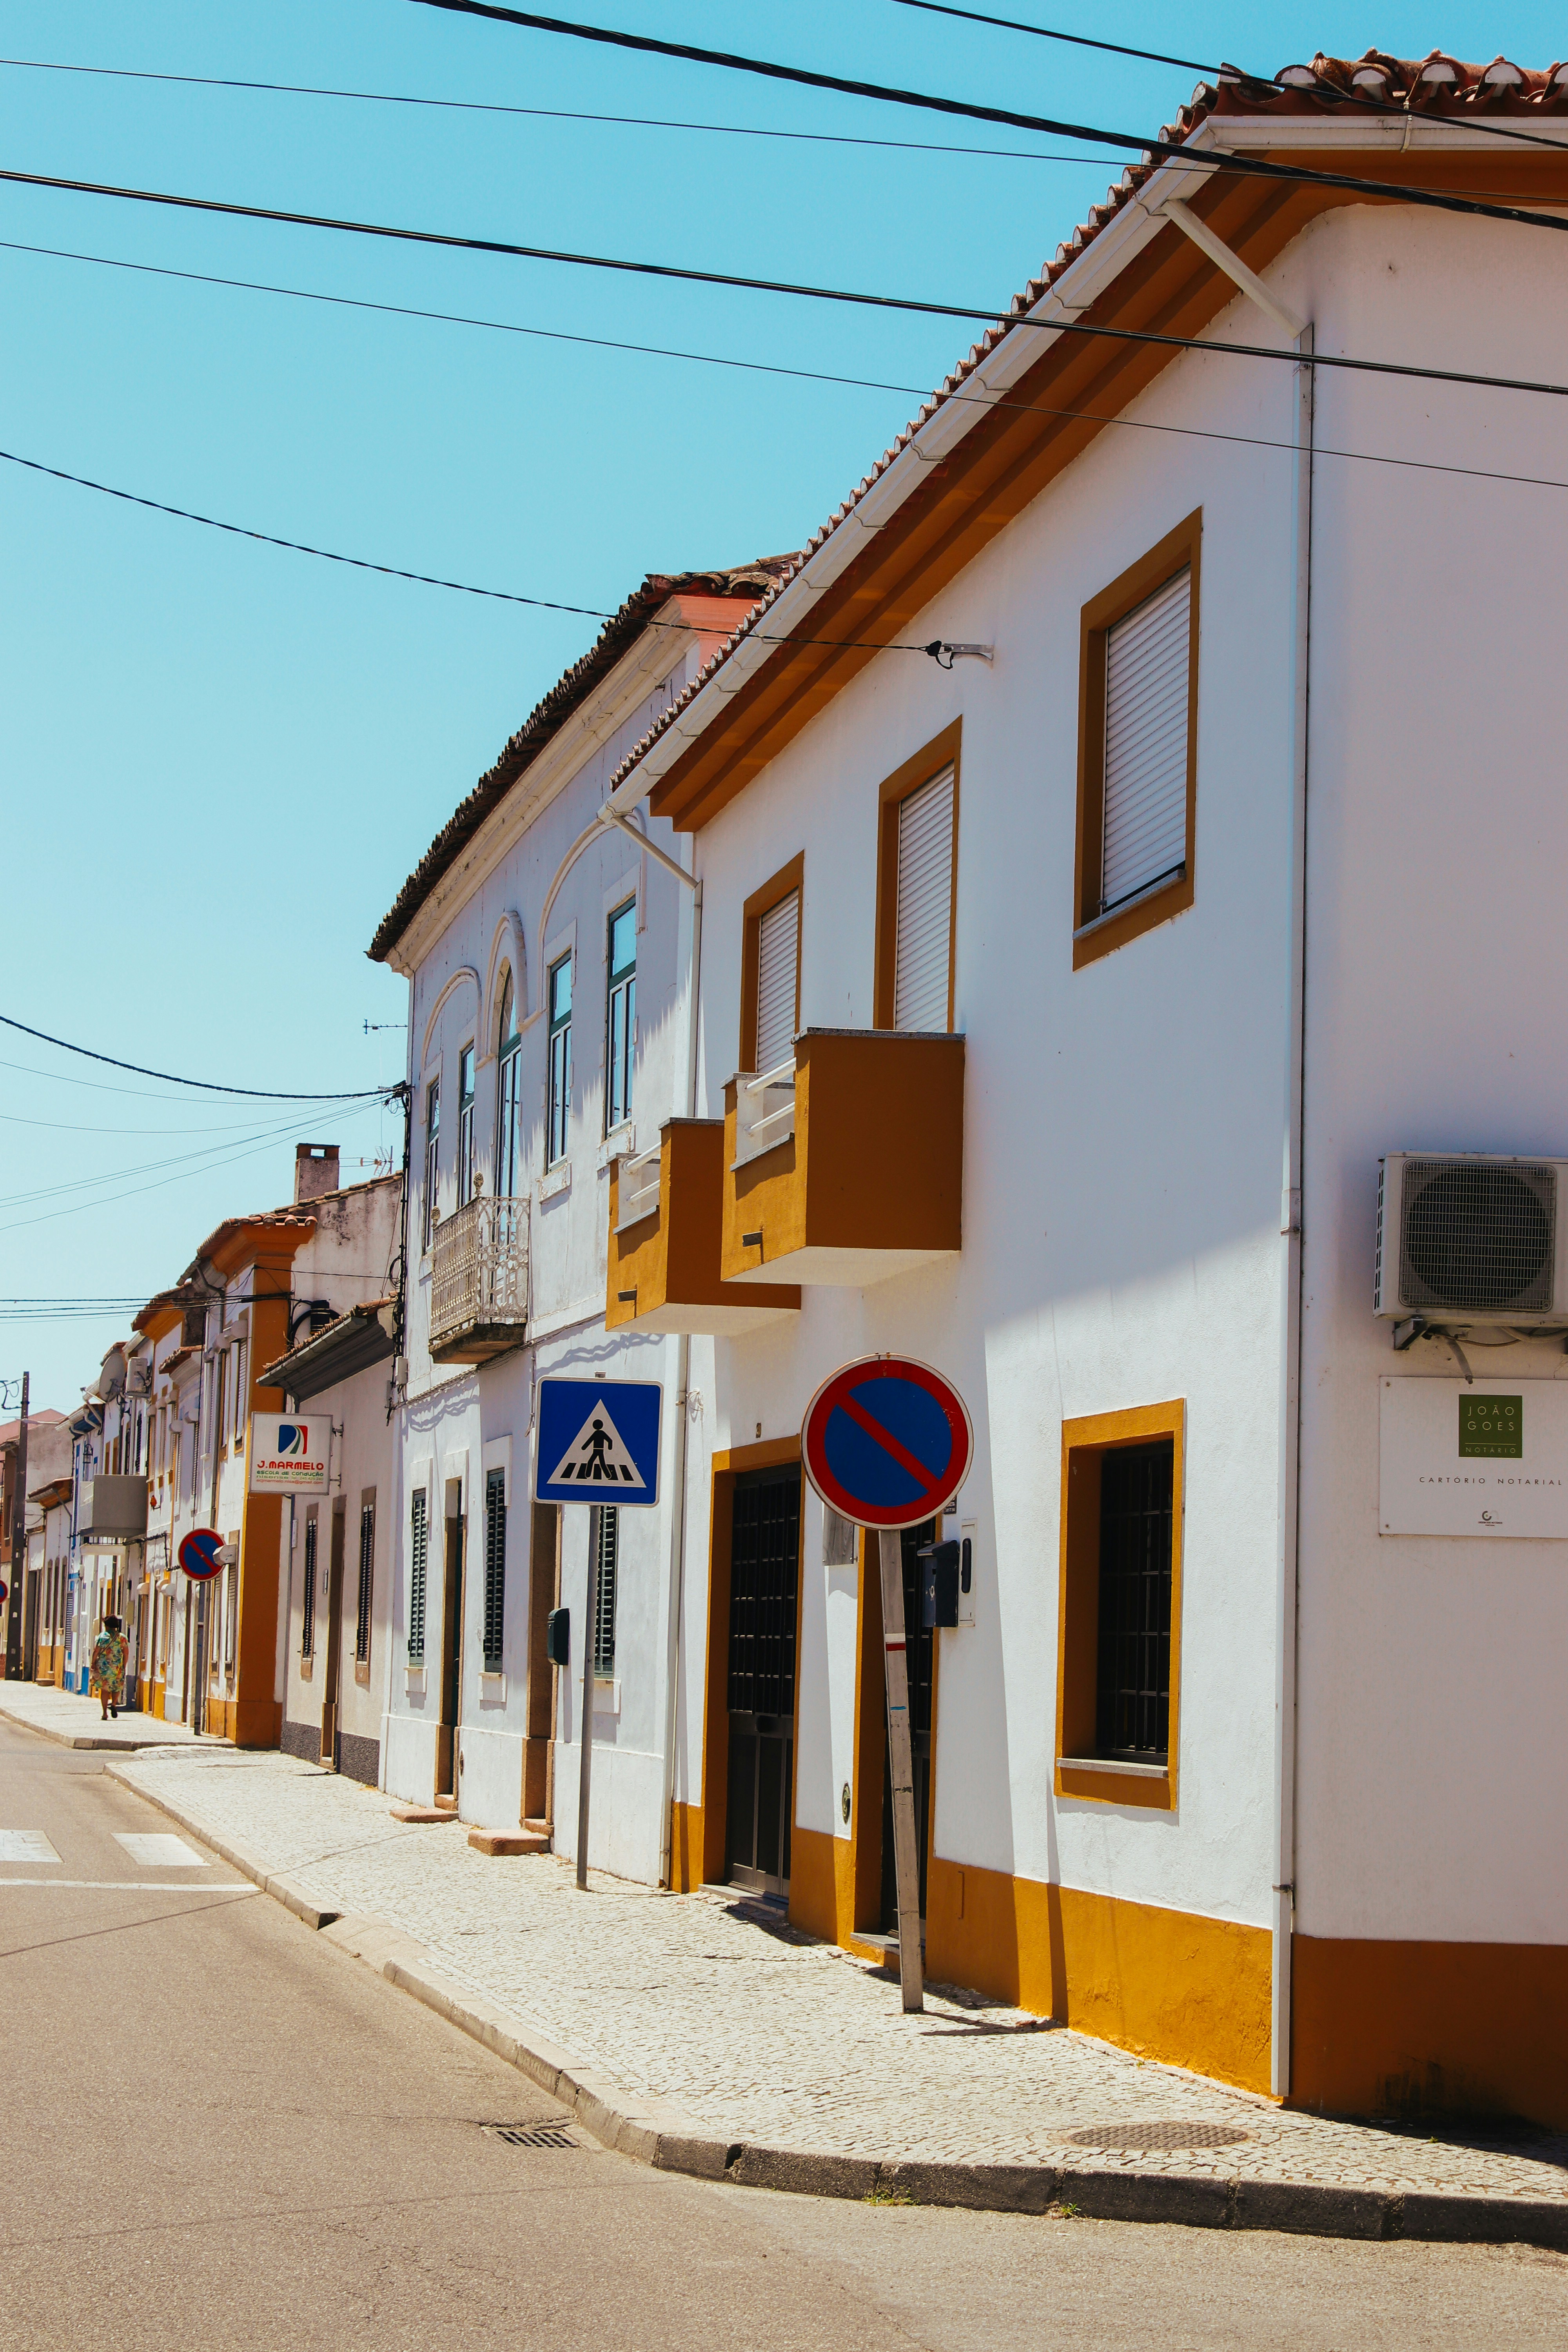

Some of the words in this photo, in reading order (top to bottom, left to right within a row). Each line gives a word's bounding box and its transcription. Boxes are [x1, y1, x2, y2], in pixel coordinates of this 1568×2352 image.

[1468, 1405, 1514, 1416] JOÃO
[1468, 1421, 1514, 1431] GOES
[257, 1460, 324, 1470] J.MARMELO
